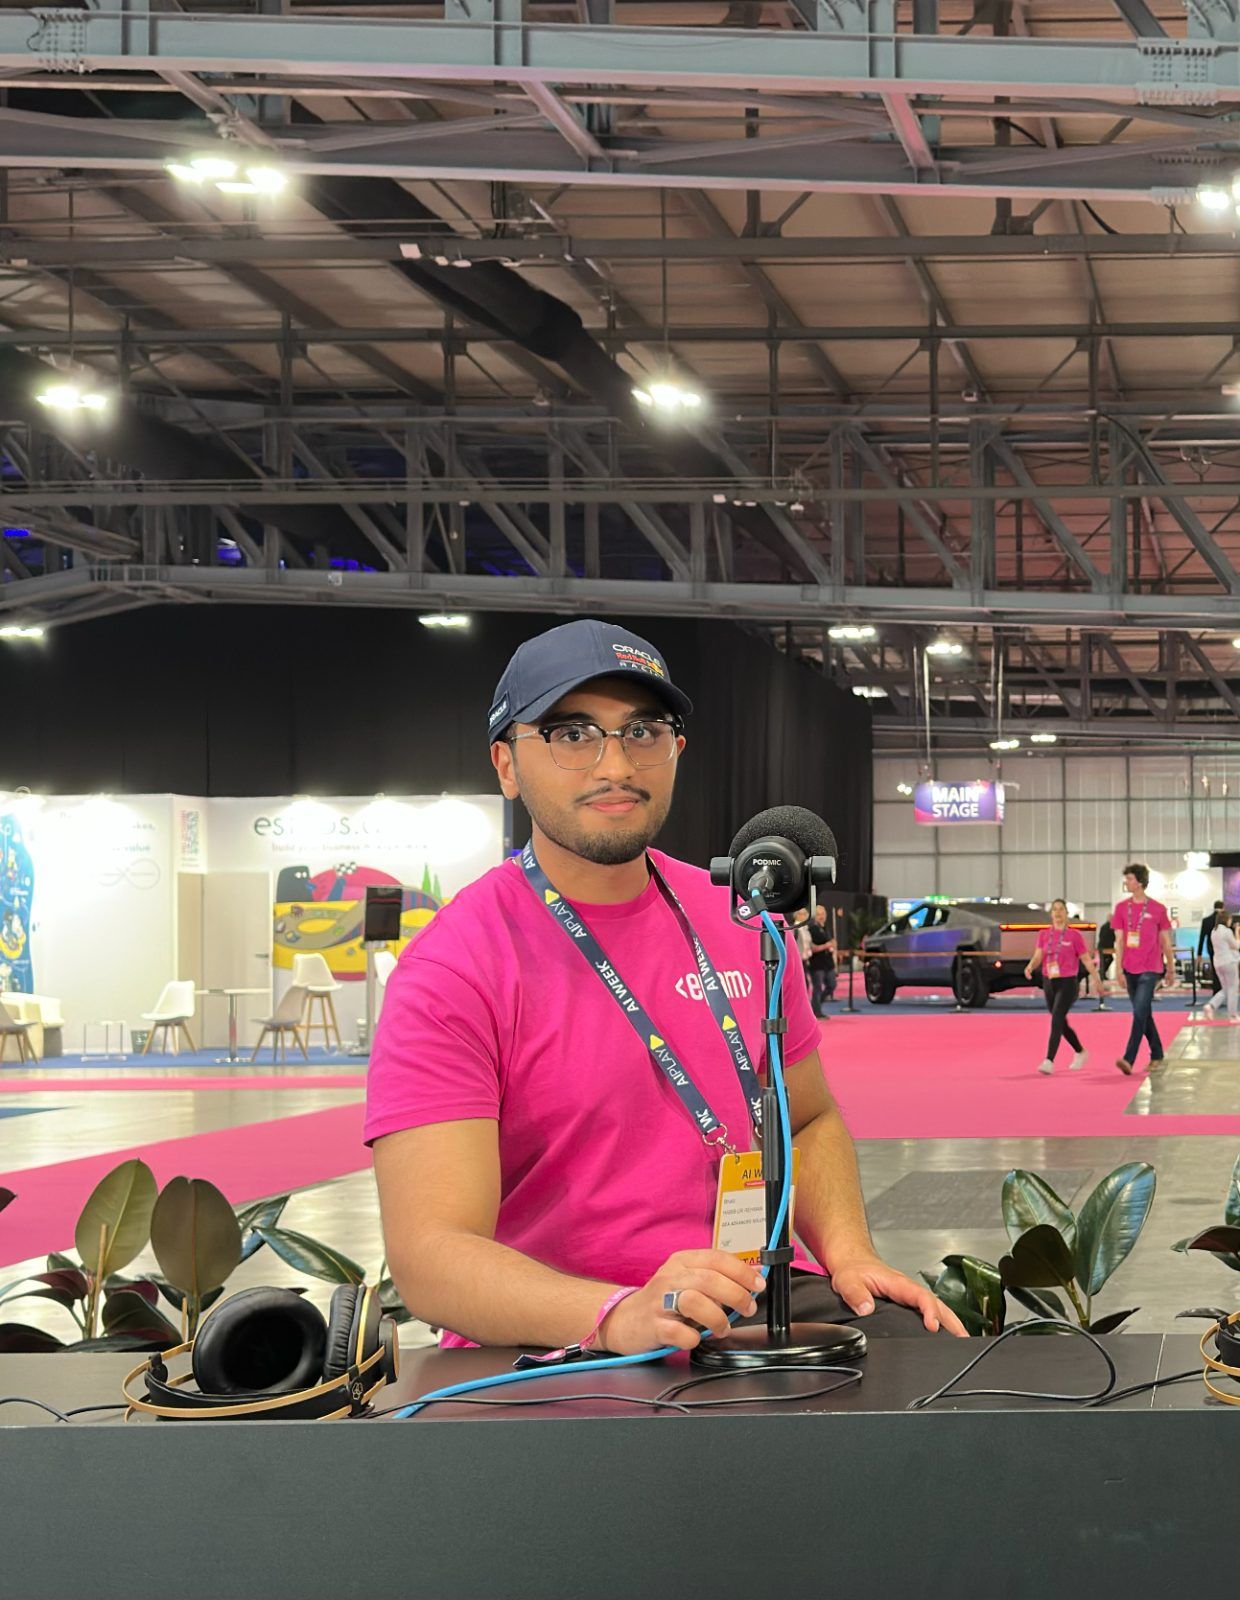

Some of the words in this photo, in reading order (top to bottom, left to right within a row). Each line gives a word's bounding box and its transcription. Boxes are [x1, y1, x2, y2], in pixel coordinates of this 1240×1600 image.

[932, 786, 981, 803] MAIN
[932, 803, 979, 818] STAGE
[752, 858, 782, 866] PODMIC
[549, 901, 588, 938] AIPLAY
[595, 960, 628, 999] WEEK
[703, 976, 718, 991] AI
[622, 998, 640, 1013] AI
[726, 1030, 750, 1071] AIPLAY
[655, 1048, 689, 1086] AIPLAY
[741, 1168, 752, 1180] AI
